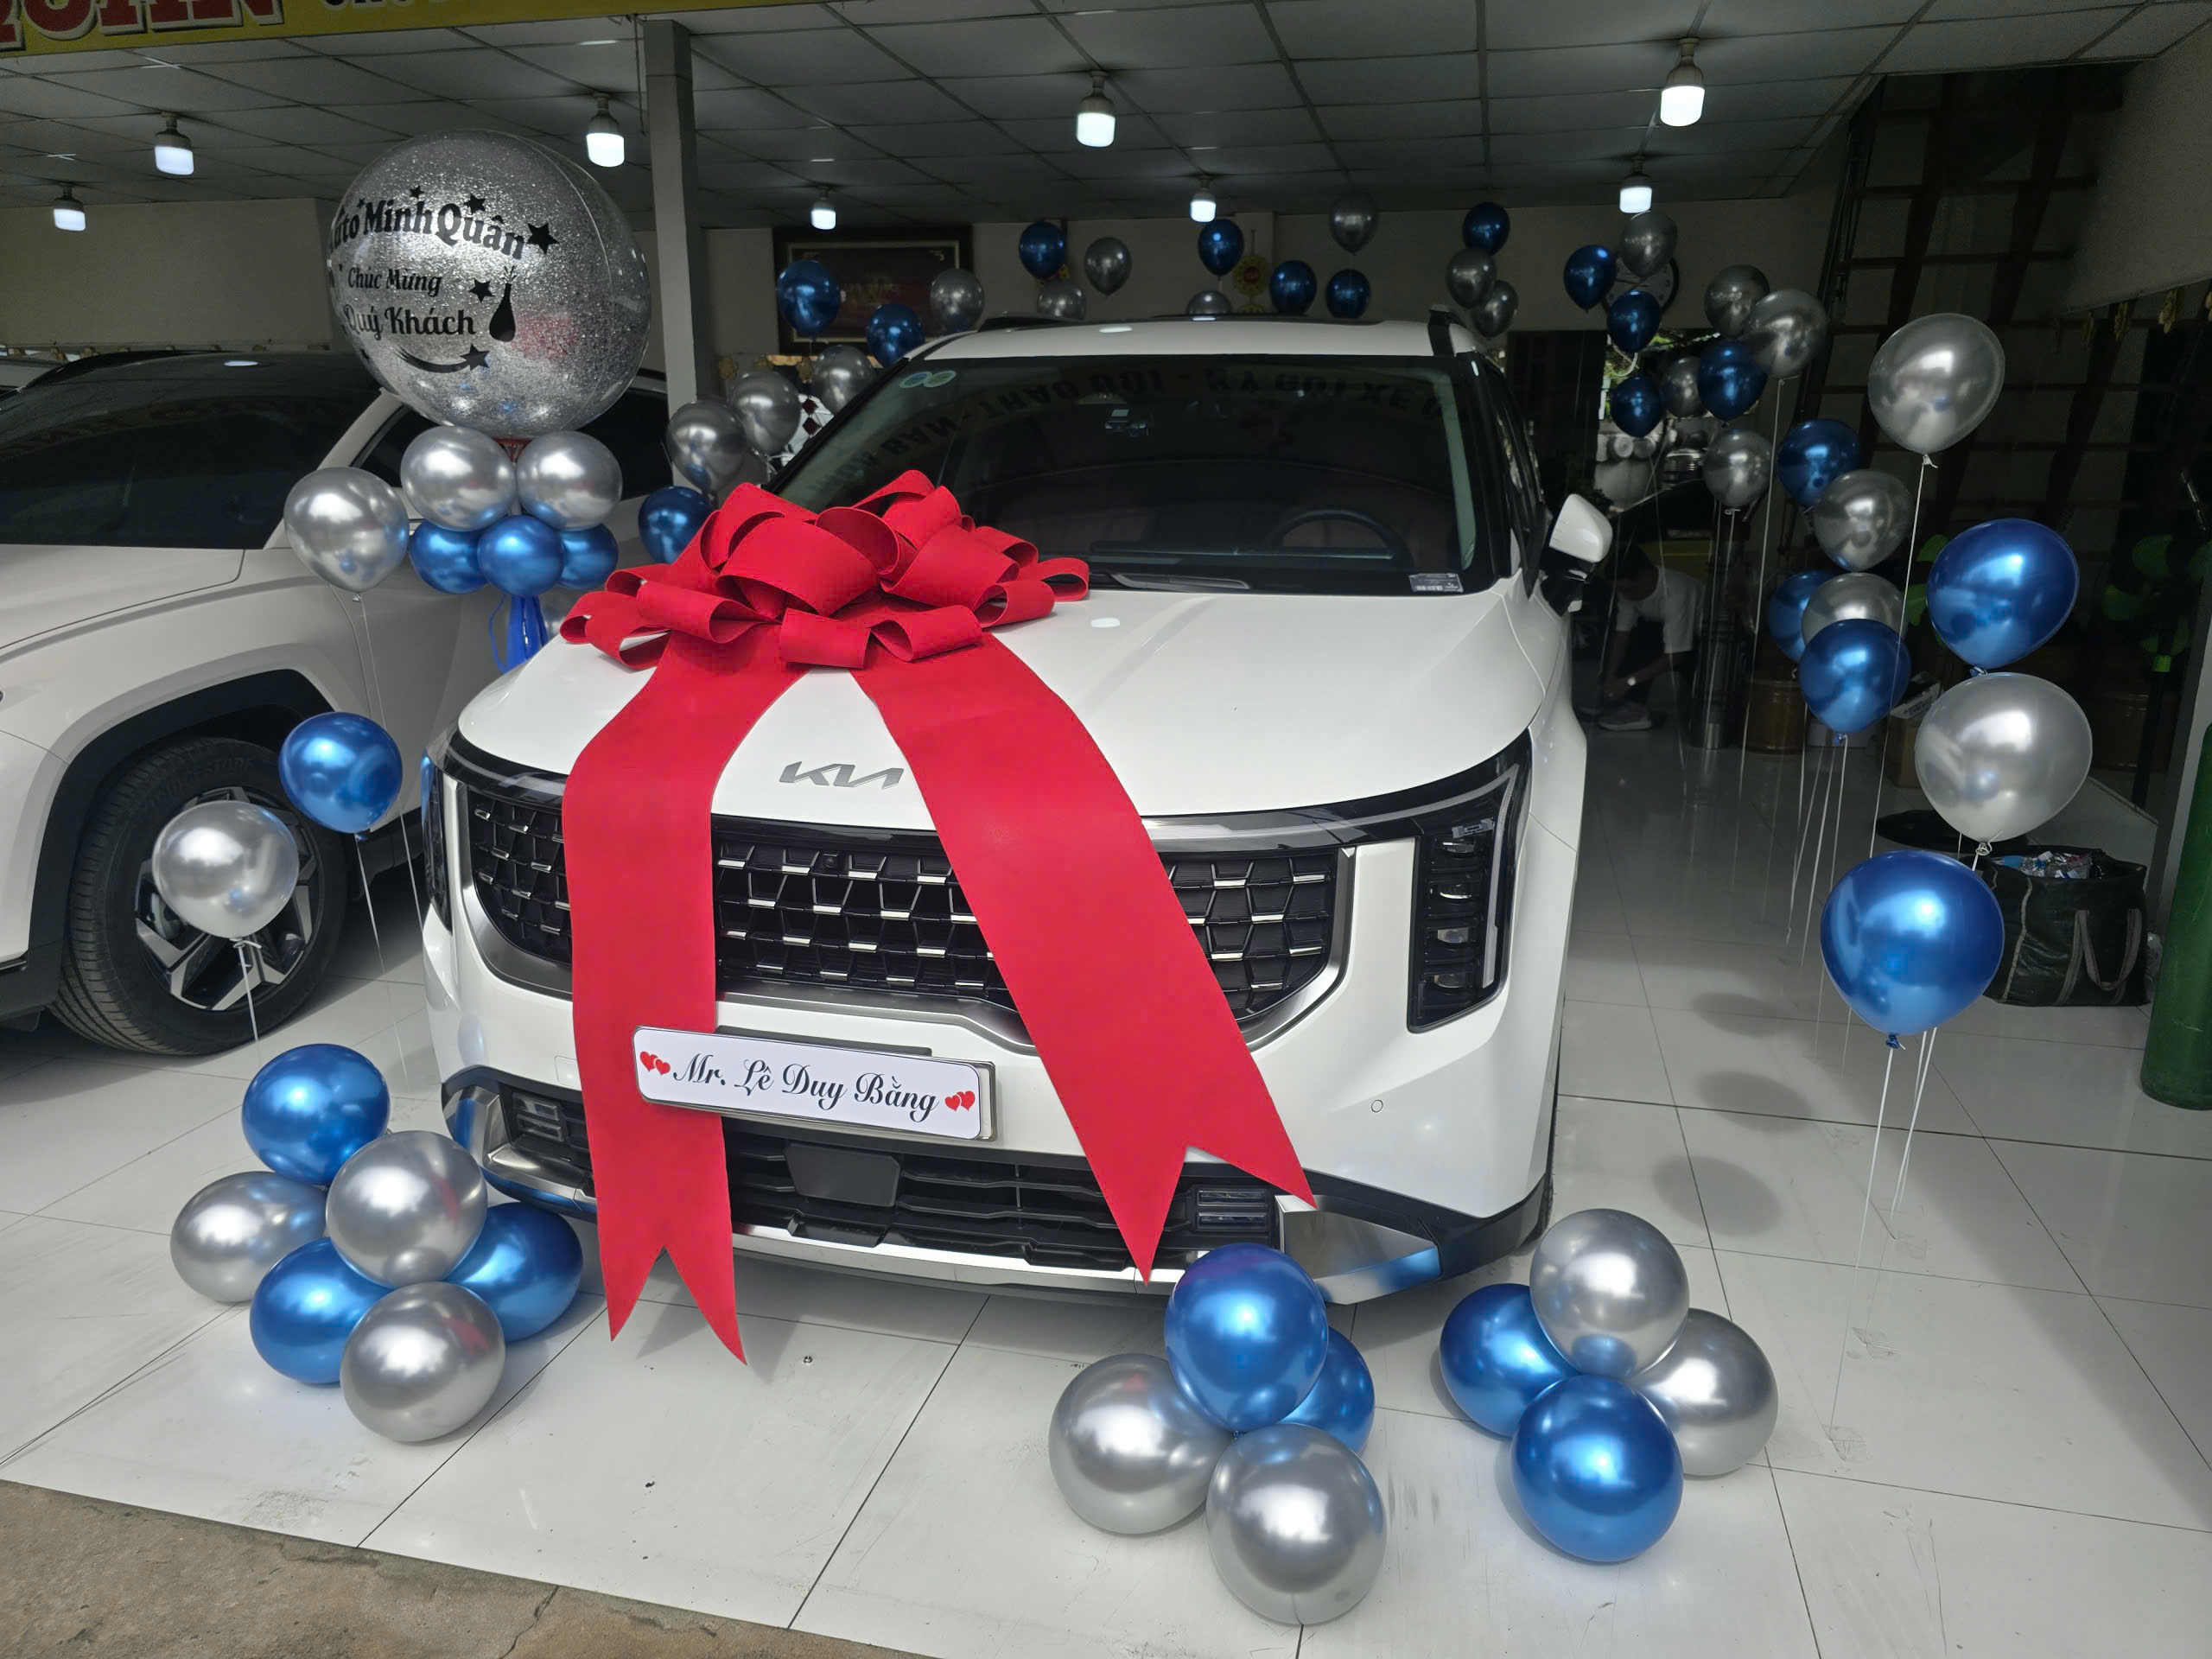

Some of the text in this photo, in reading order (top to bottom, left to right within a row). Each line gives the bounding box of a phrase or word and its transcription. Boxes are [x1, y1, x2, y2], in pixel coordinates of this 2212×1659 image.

[435, 203, 524, 260] Quân
[347, 267, 383, 289] Chúc
[343, 304, 477, 341] Quý Khách
[779, 760, 904, 790] KIA
[673, 1052, 939, 1122] Mr. Lê Duy Bằng
